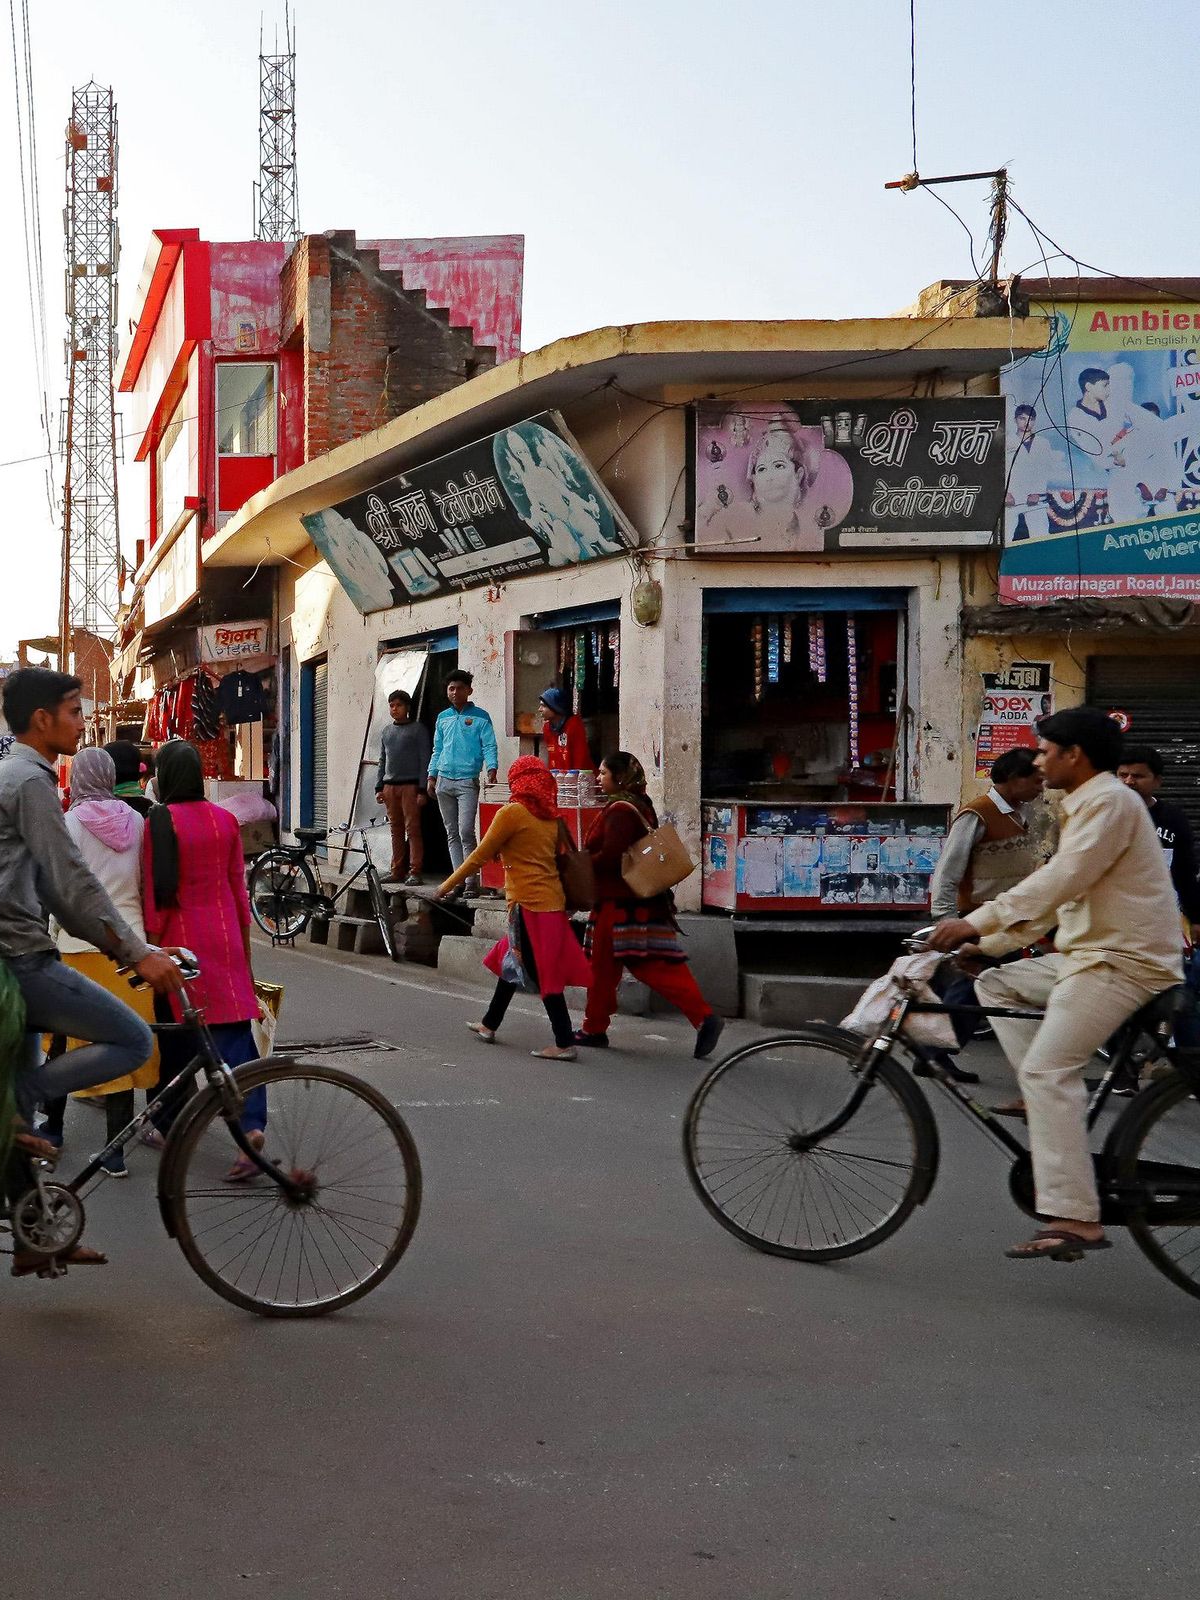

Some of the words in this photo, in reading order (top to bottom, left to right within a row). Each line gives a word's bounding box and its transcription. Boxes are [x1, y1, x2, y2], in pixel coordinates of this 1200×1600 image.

[1121, 336, 1142, 347] (An
[1146, 335, 1187, 347] English
[860, 407, 918, 468] श्री
[929, 420, 1000, 466] राम
[366, 494, 402, 549] श्री
[1103, 522, 1200, 551] Ambienc
[1143, 540, 1200, 561] wher
[1012, 576, 1123, 593] Muzaffarnagar
[982, 696, 1034, 716] apex
[1000, 711, 1028, 720] ADDA
[1156, 826, 1176, 843] ALS
